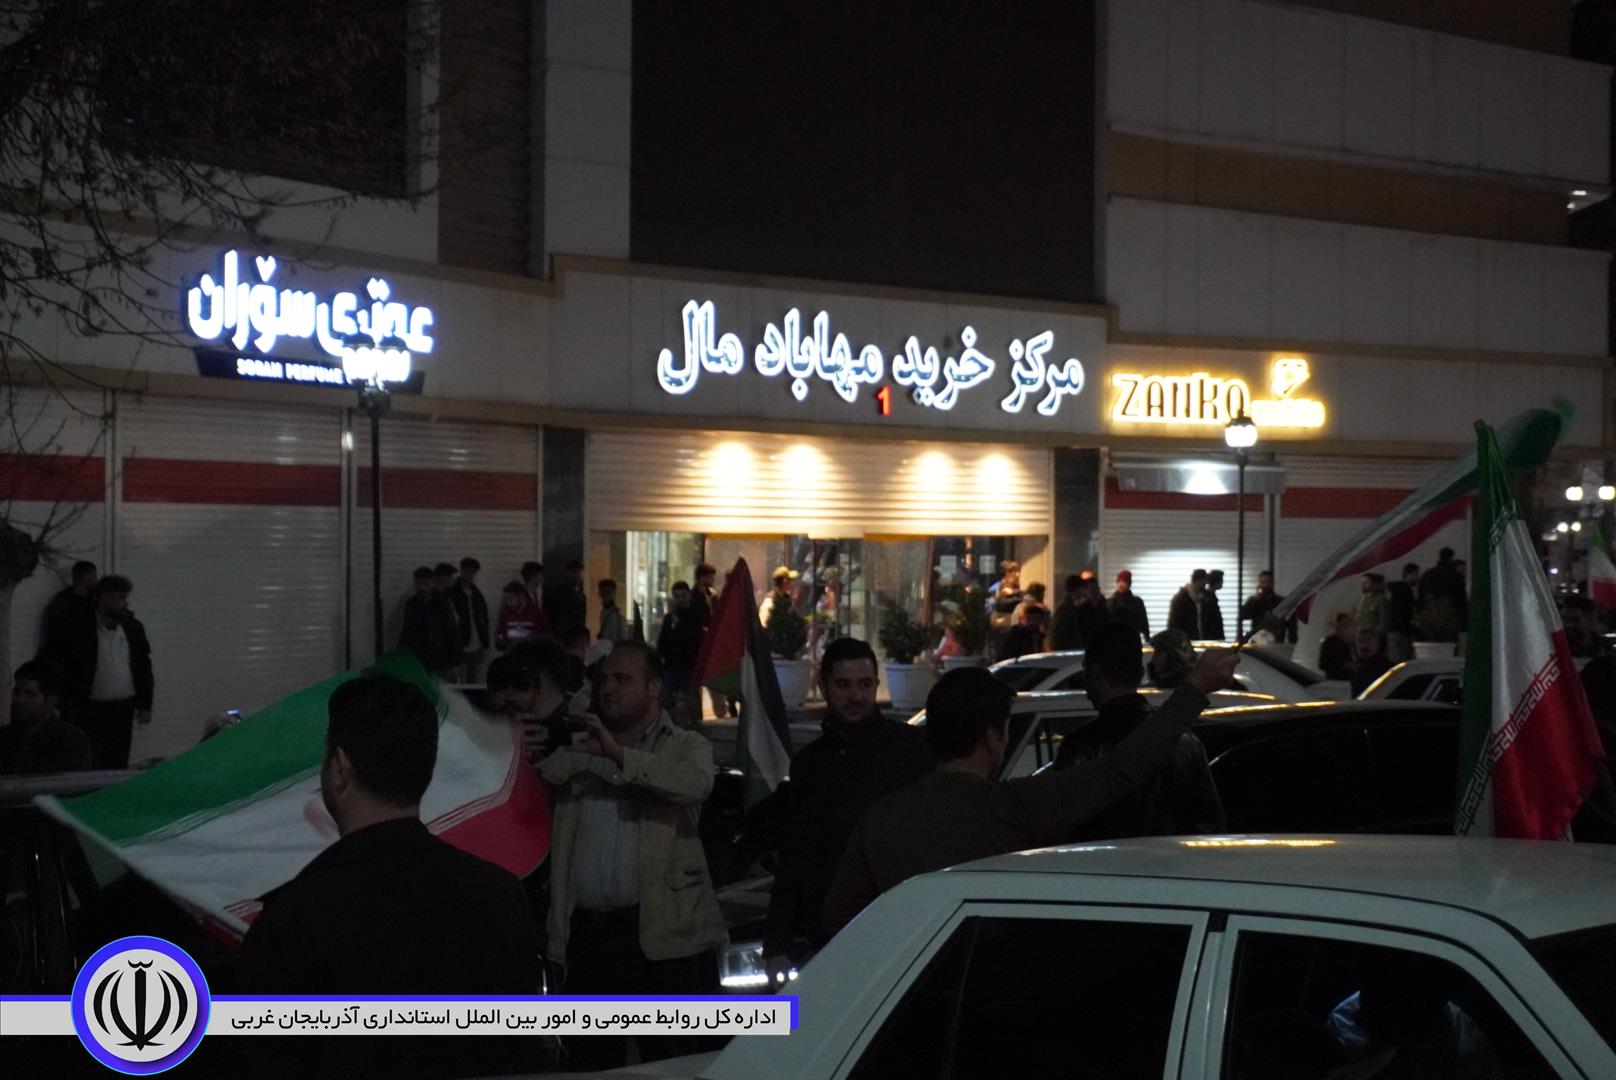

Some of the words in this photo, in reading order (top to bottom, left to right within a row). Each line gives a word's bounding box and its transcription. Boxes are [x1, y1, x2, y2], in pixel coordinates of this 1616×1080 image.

[656, 299, 744, 395] مال
[754, 307, 884, 402] مهاباد
[892, 325, 996, 411] خرید
[1001, 330, 1085, 417] مرکز
[875, 385, 892, 417] 1
